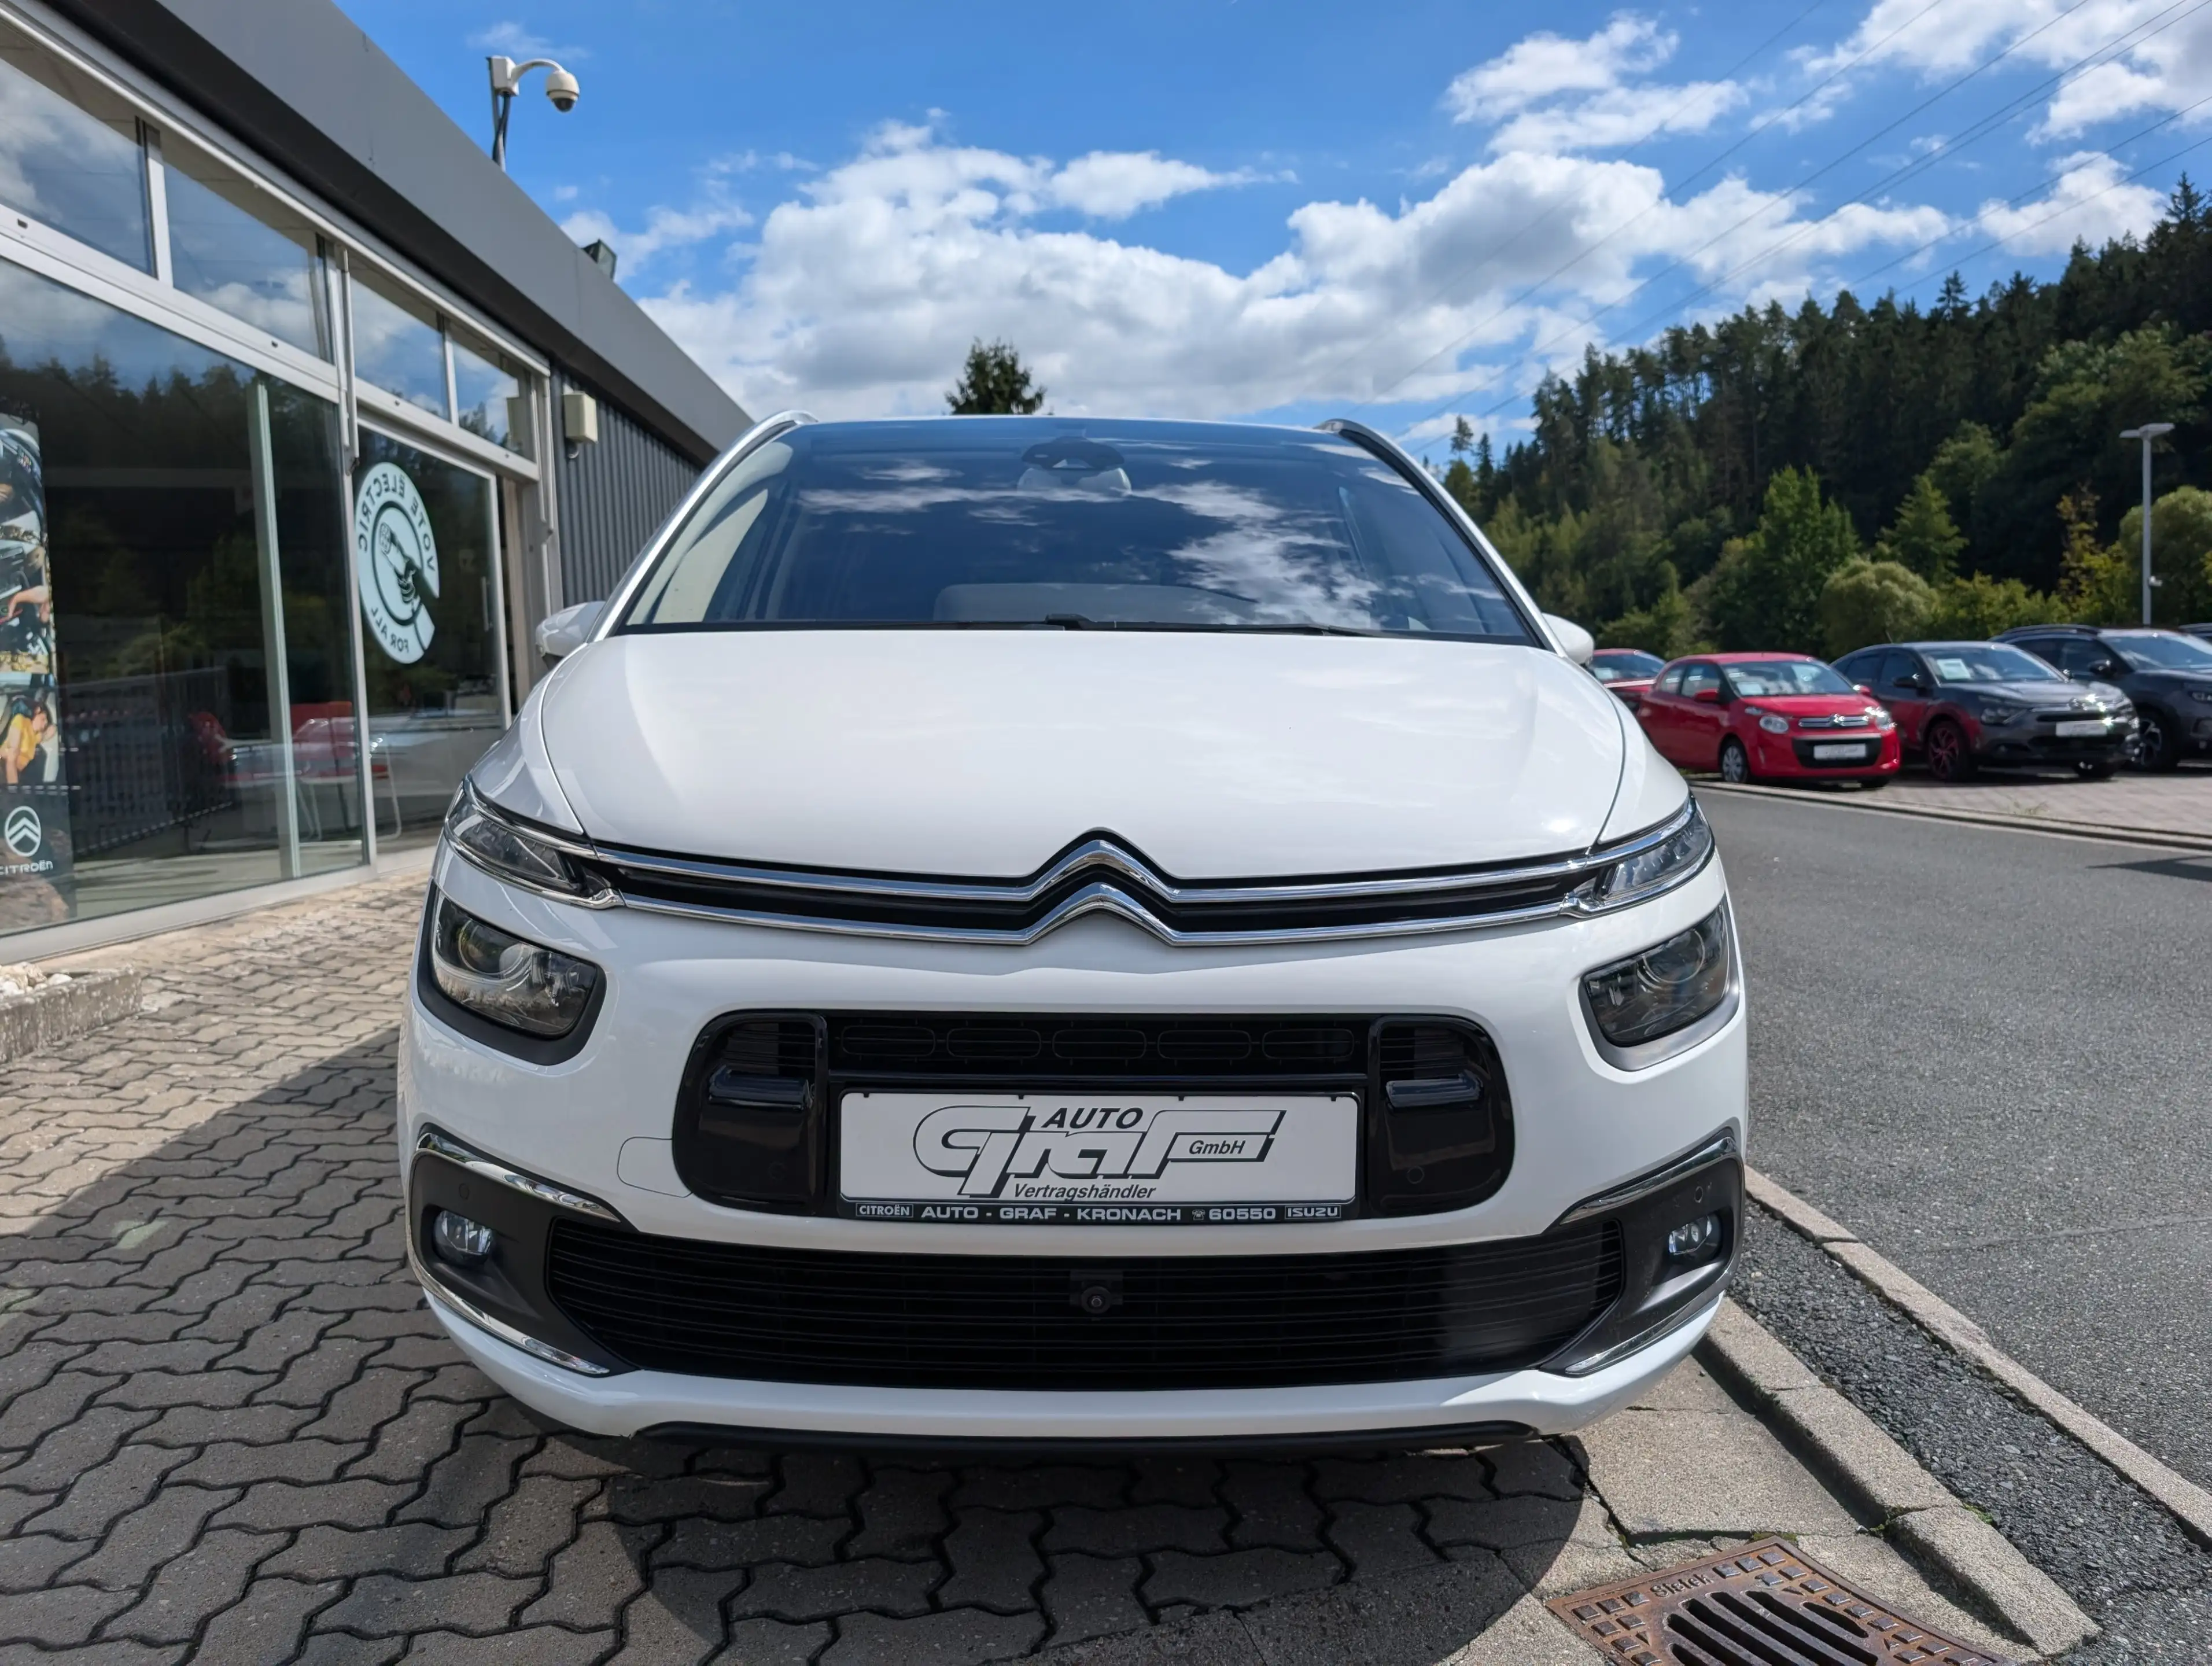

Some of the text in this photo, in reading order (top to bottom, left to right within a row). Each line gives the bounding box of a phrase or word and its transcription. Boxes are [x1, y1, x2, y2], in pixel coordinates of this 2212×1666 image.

[1041, 1107, 1144, 1129] AUTO
[1188, 1140, 1246, 1155] GmbH
[1014, 1183, 1156, 1201] Vertragshändler
[859, 1204, 910, 1216] CITROËN
[921, 1207, 978, 1219] AUTO
[1000, 1207, 1057, 1219] GRAF
[1077, 1207, 1181, 1221] KRONACH
[1209, 1208, 1276, 1221] 60550
[1288, 1207, 1338, 1217] ISUZU
